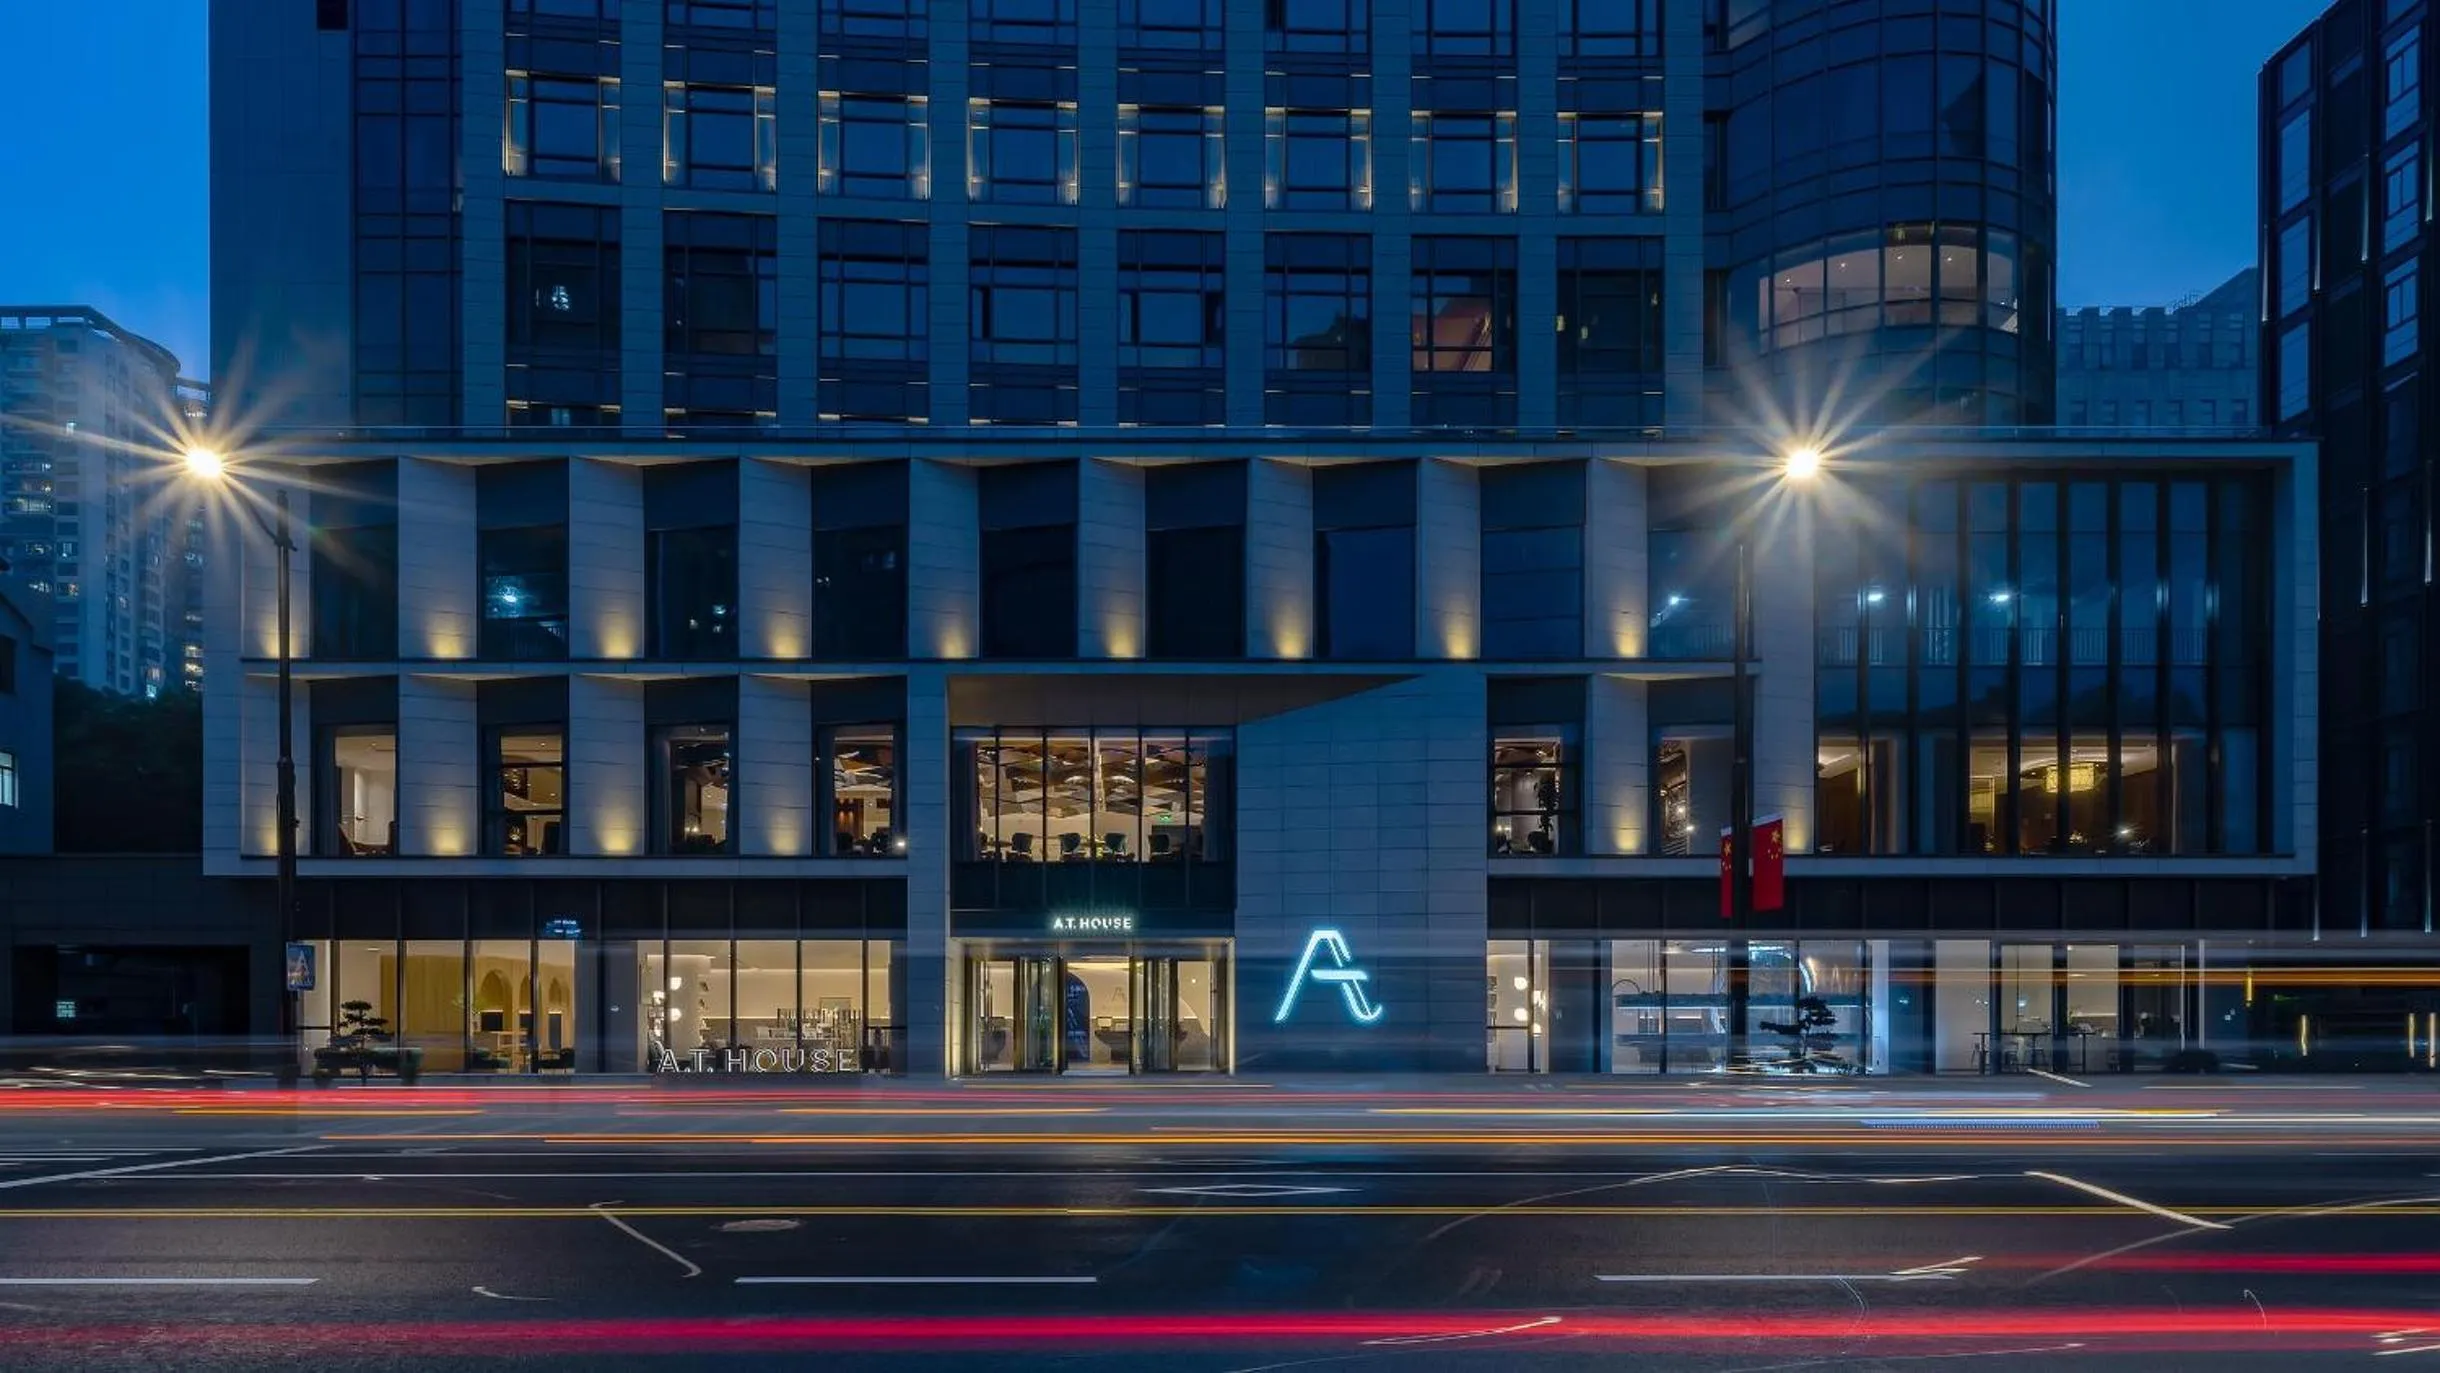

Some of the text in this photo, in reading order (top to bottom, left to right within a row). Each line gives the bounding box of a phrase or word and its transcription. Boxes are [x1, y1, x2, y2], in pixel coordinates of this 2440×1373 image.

[1053, 917, 1132, 930] A.T. HOUSE
[657, 1048, 860, 1073] A.T. HOUSE
